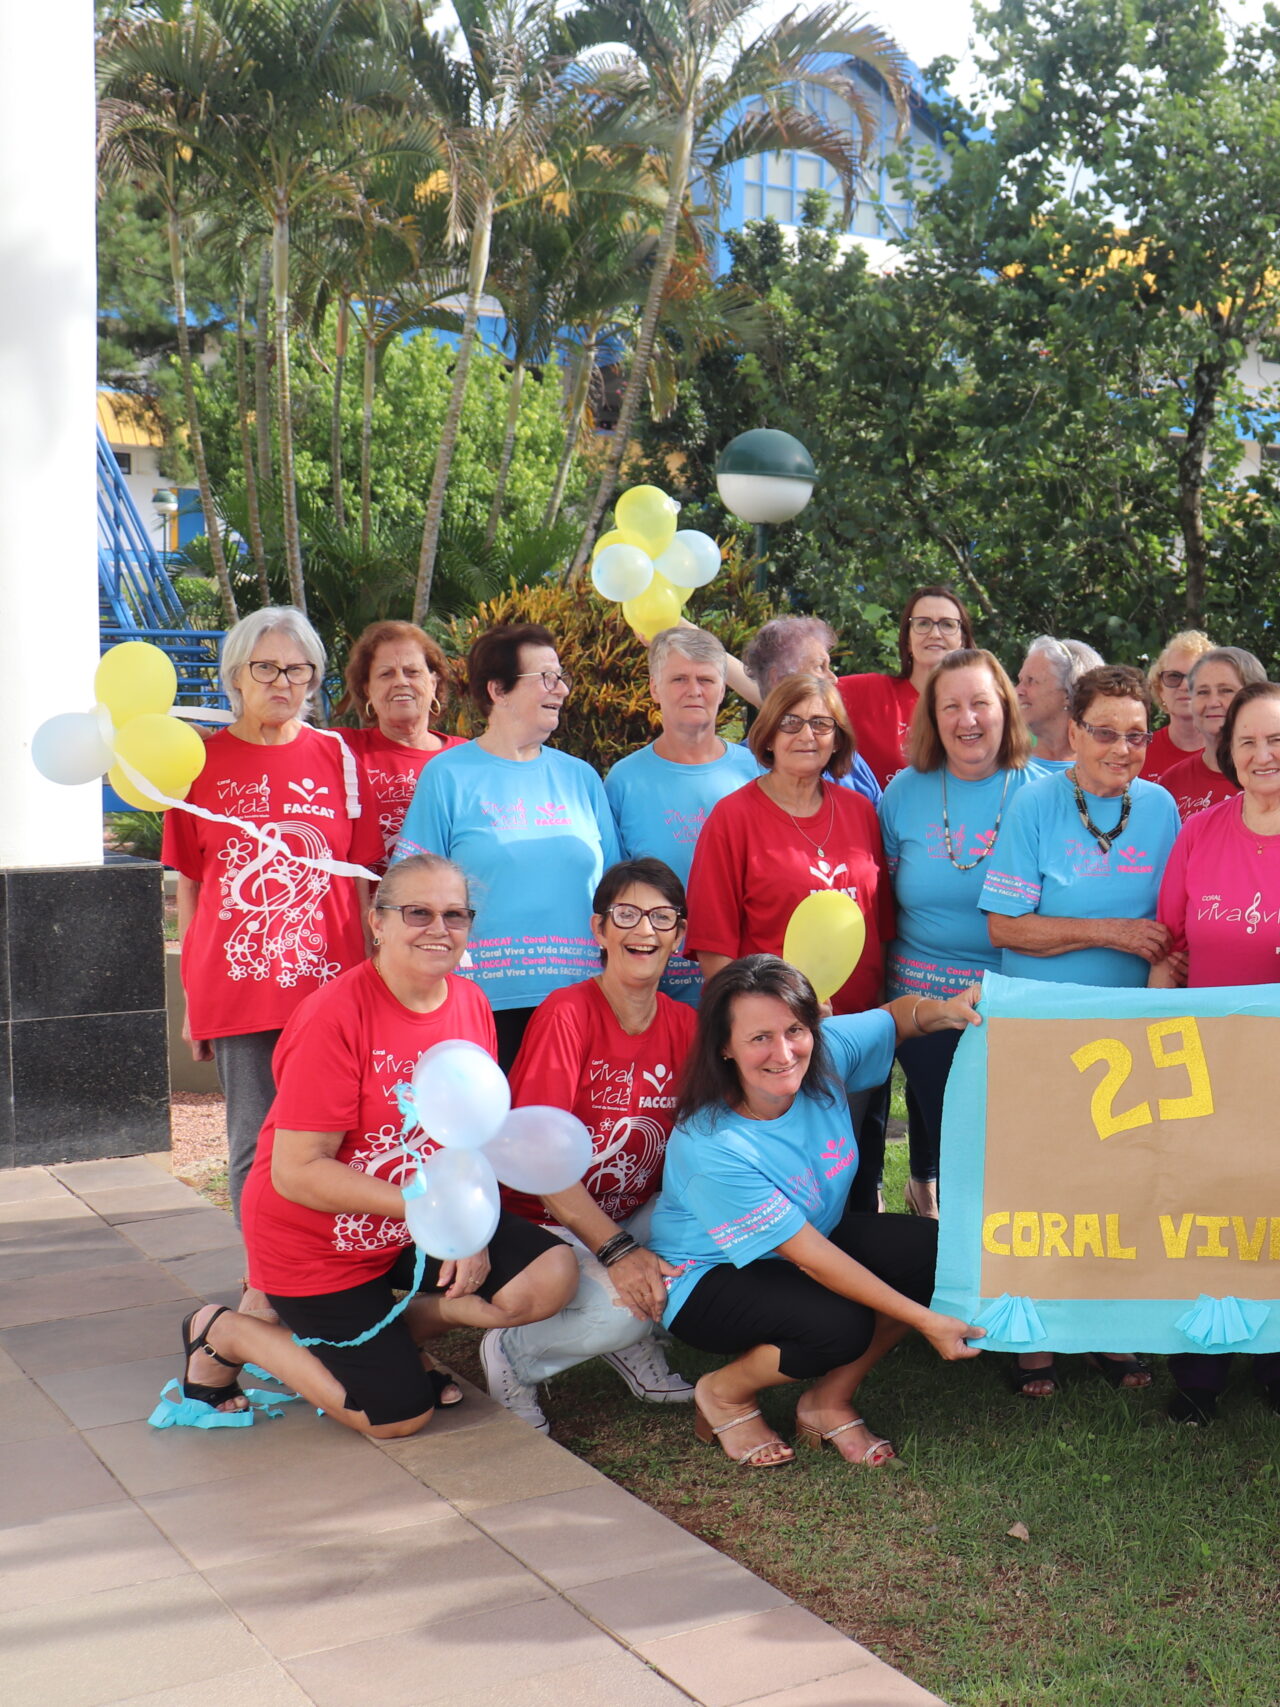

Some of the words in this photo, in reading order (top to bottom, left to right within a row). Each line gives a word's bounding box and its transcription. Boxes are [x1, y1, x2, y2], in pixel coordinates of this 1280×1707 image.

[218, 782, 259, 800] viva
[225, 798, 270, 817] vida
[283, 803, 336, 819] FACCAT
[1197, 903, 1242, 922] viva
[480, 936, 513, 948] FACCAT
[522, 936, 548, 944] Coral
[550, 935, 568, 944] Viva
[480, 948, 502, 958] Coral
[504, 947, 525, 956] Viva
[536, 945, 558, 954] Vida
[480, 958, 513, 969] FACCAT
[521, 957, 547, 965] Coral
[668, 960, 691, 968] Coral
[482, 970, 504, 979] Coral
[506, 968, 526, 977] Viva
[537, 966, 559, 975] Vida
[904, 968, 925, 978] Coral
[926, 972, 946, 983] Viva
[946, 966, 972, 977] Coral
[669, 976, 692, 985] Coral
[373, 1054, 415, 1074] viva
[590, 1063, 628, 1083] viva
[1070, 1015, 1214, 1141] 29
[591, 1086, 631, 1105] vida
[638, 1096, 679, 1109] FACCAT
[982, 1211, 1137, 1260] CORAL
